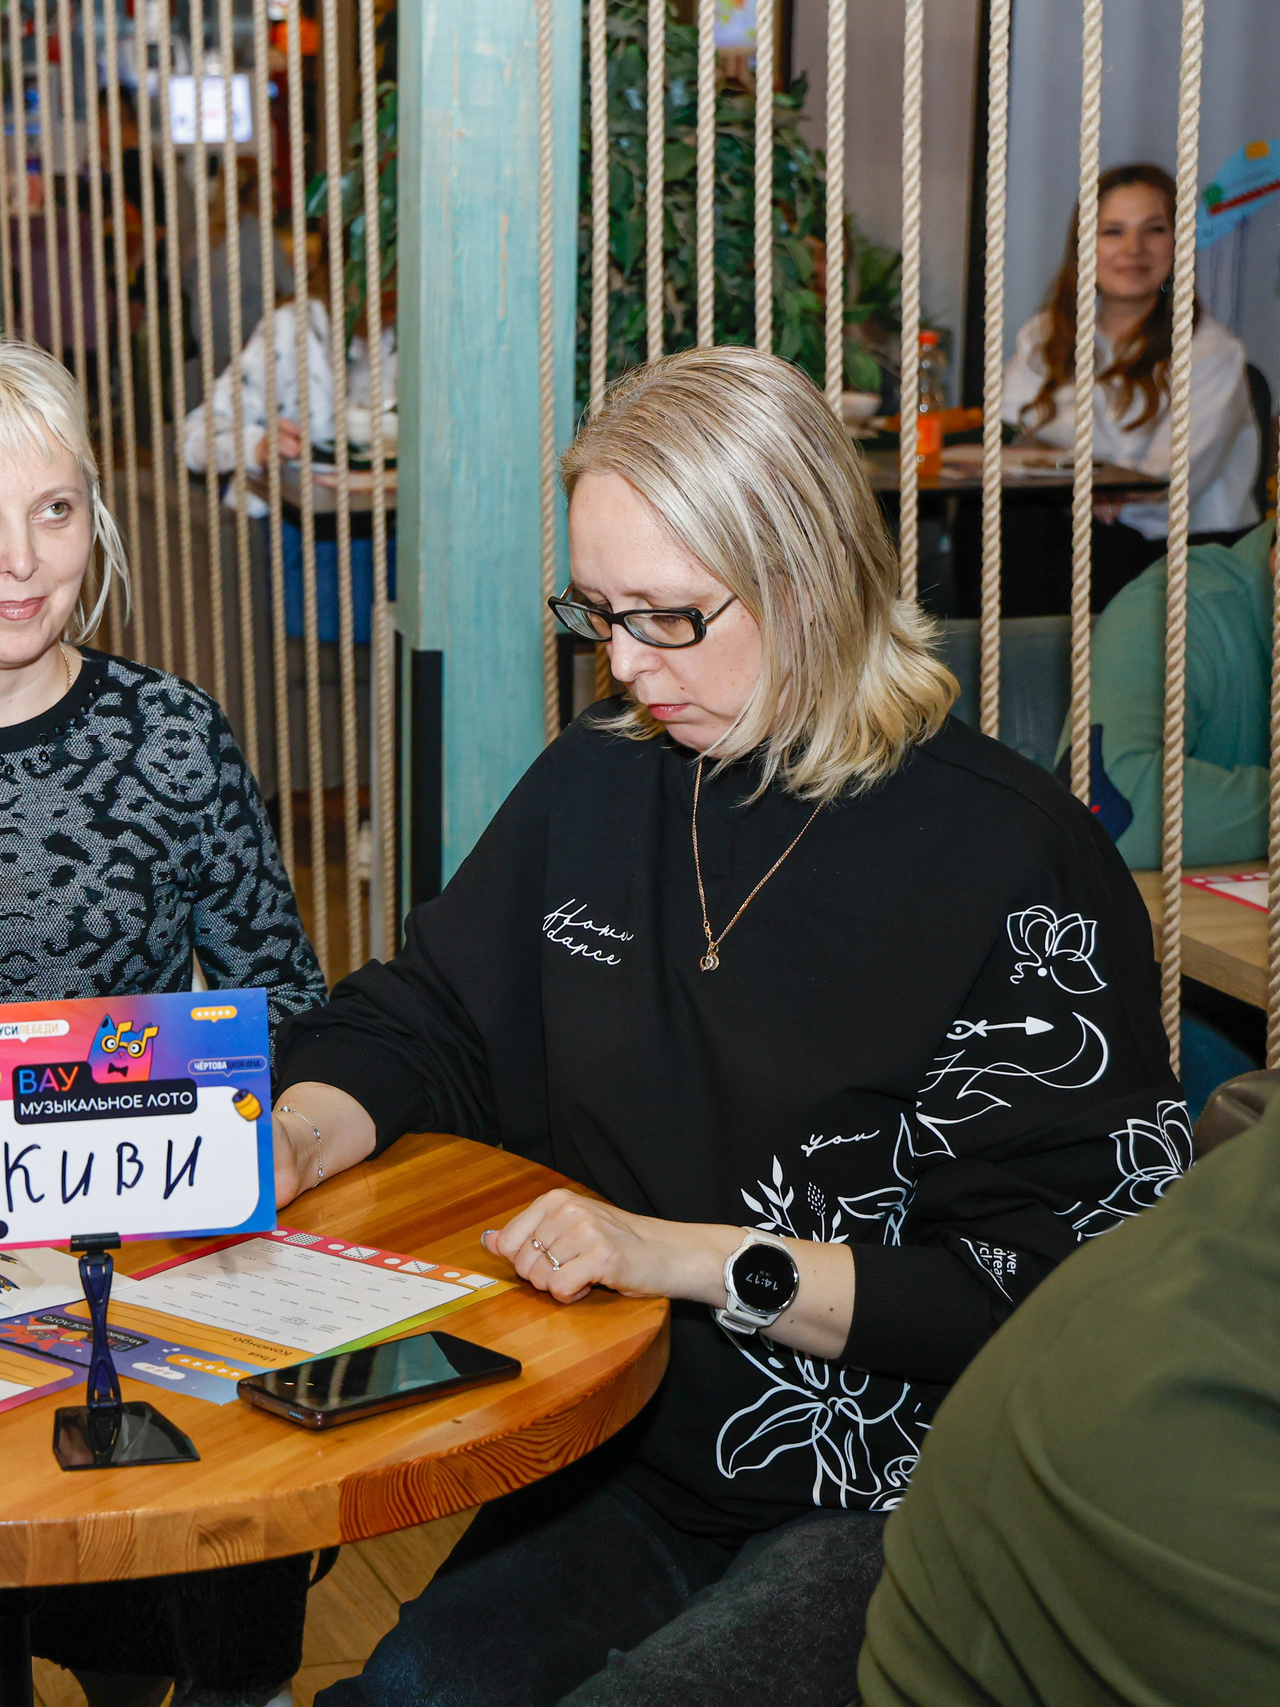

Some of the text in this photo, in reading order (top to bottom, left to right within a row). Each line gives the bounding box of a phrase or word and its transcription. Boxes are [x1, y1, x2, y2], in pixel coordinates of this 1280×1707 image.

[18, 1065, 80, 1095] ВАУ
[19, 1091, 194, 1116] МУЗЫКАЛЬНОЕ ЛОТО
[3, 1135, 203, 1214] КИВИ
[992, 1248, 1007, 1286] drea
[1006, 1250, 1017, 1275] ver
[745, 1272, 778, 1291] 14:17
